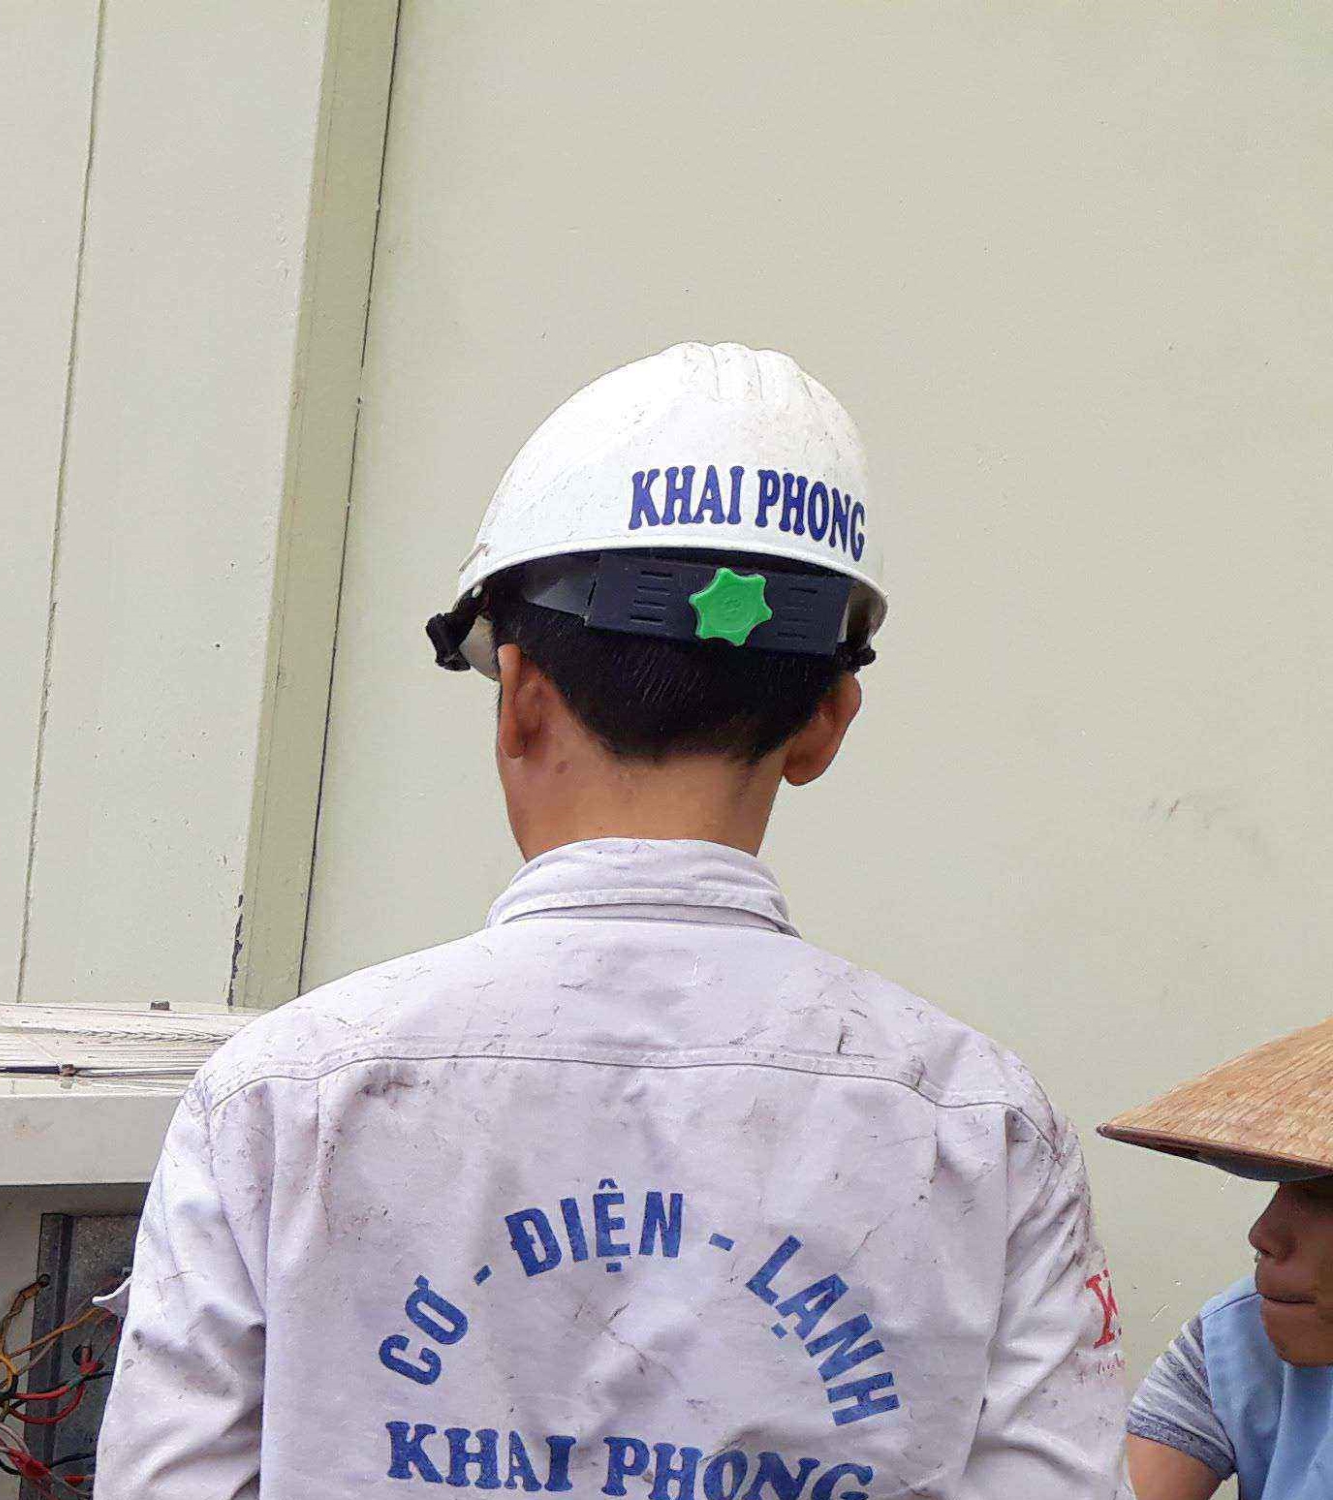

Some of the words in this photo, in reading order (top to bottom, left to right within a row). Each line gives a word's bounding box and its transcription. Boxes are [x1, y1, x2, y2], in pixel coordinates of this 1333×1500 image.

[630, 466, 744, 530] KHAI
[755, 468, 867, 562] PHONG
[379, 1275, 470, 1386] CƠ
[504, 1178, 686, 1277] ĐIỆN
[746, 1235, 901, 1427] LẠNH
[385, 1420, 577, 1494] KHAI
